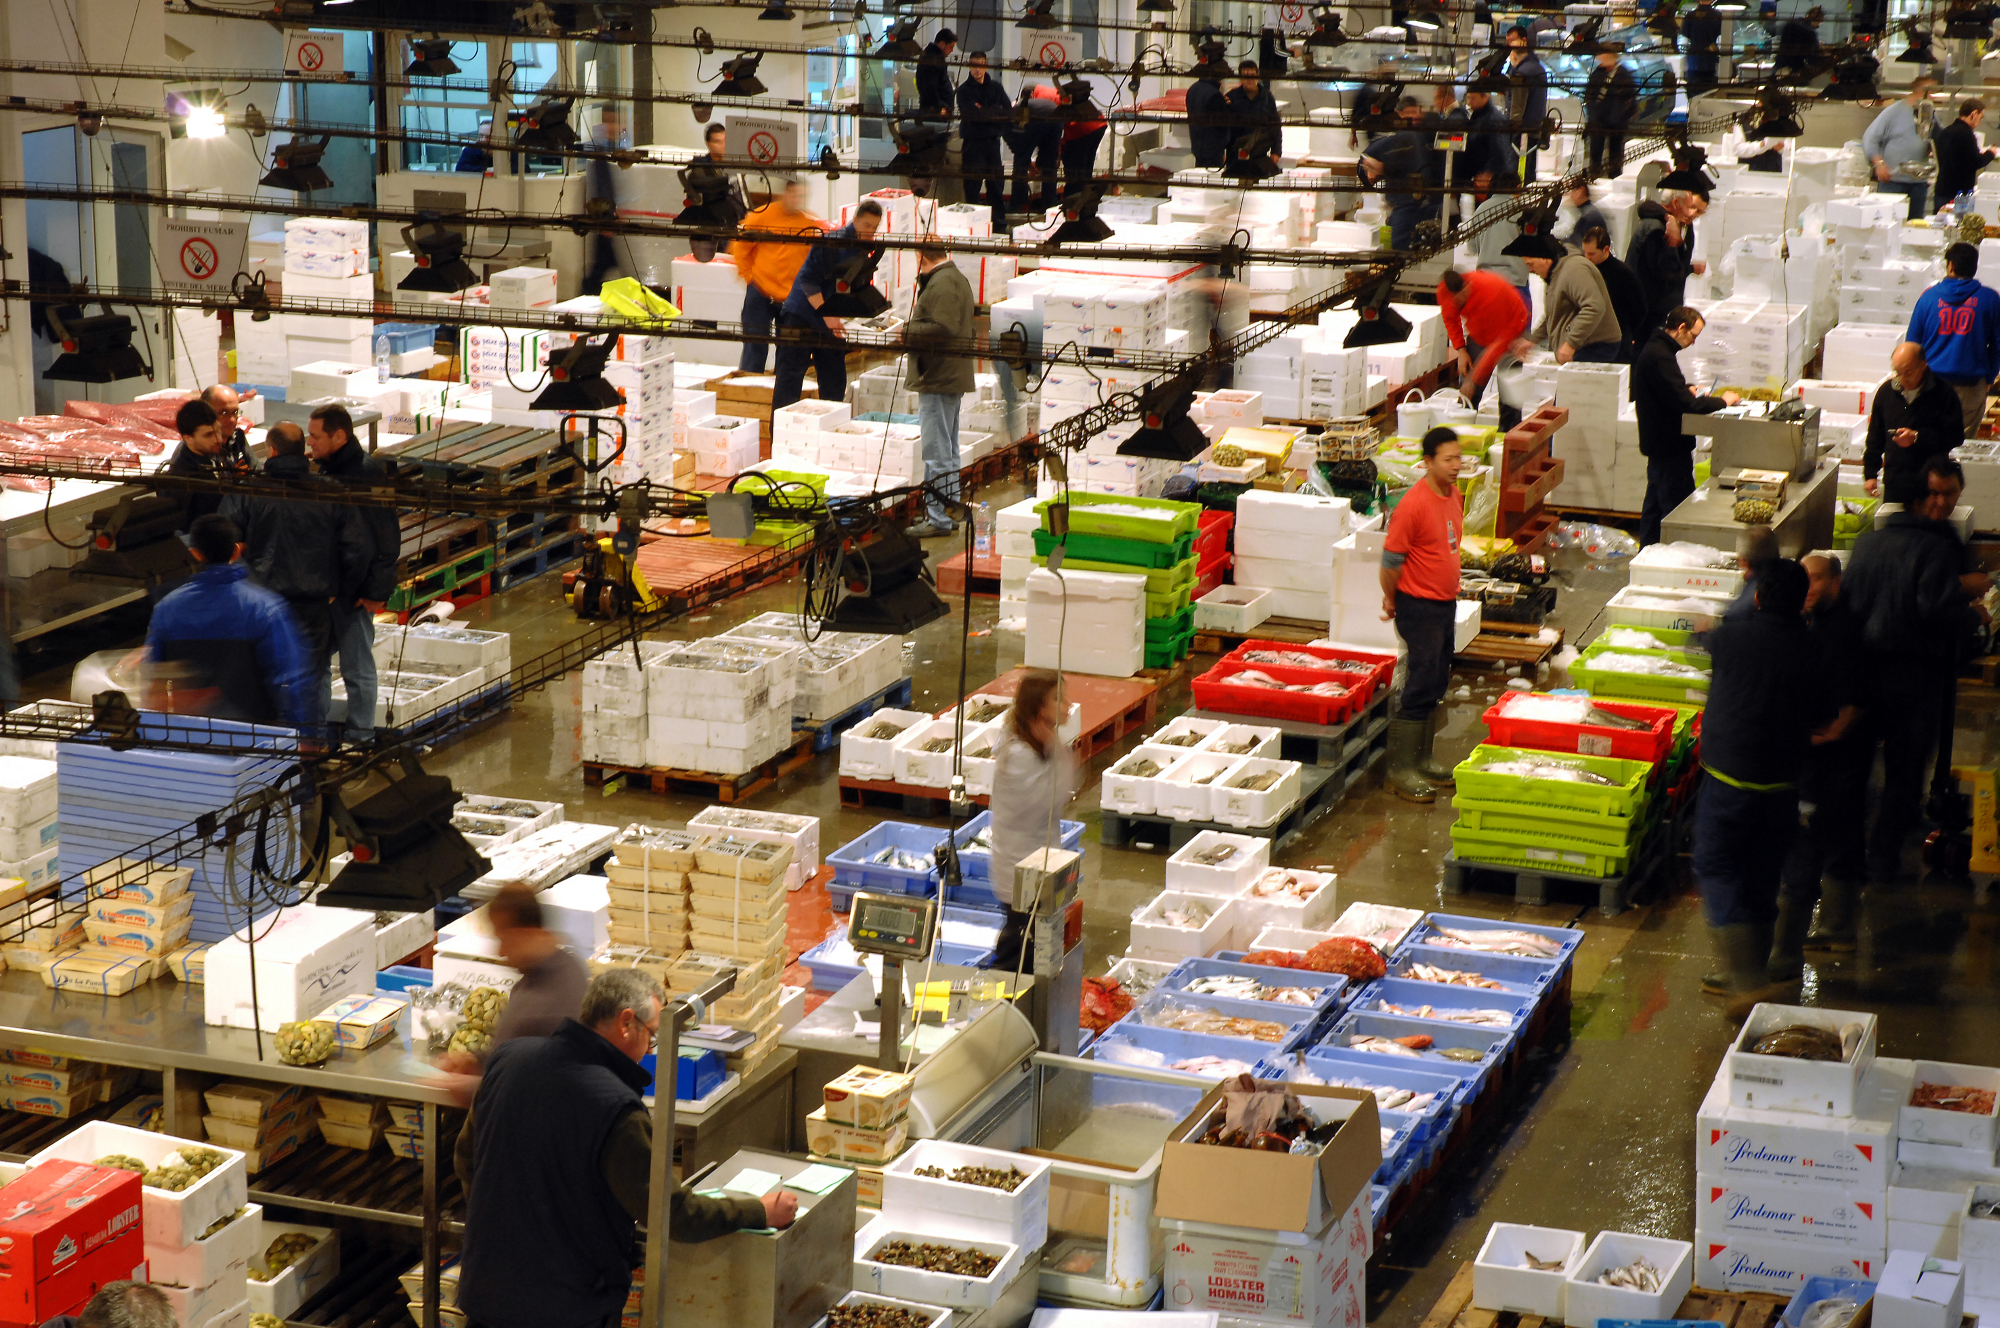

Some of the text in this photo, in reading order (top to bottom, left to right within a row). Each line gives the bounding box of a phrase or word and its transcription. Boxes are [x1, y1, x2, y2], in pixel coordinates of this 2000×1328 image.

[166, 223, 234, 235] PROHIBIT FUMAR
[1938, 306, 1976, 336] 10
[1724, 1135, 1797, 1164] Prodemar
[108, 1204, 140, 1236] LOBSTER
[1727, 1192, 1796, 1222] Prodemar
[1729, 1250, 1795, 1280] Prodemar
[1207, 1276, 1265, 1292] LOBSTER
[1208, 1287, 1265, 1304] HOMARD
